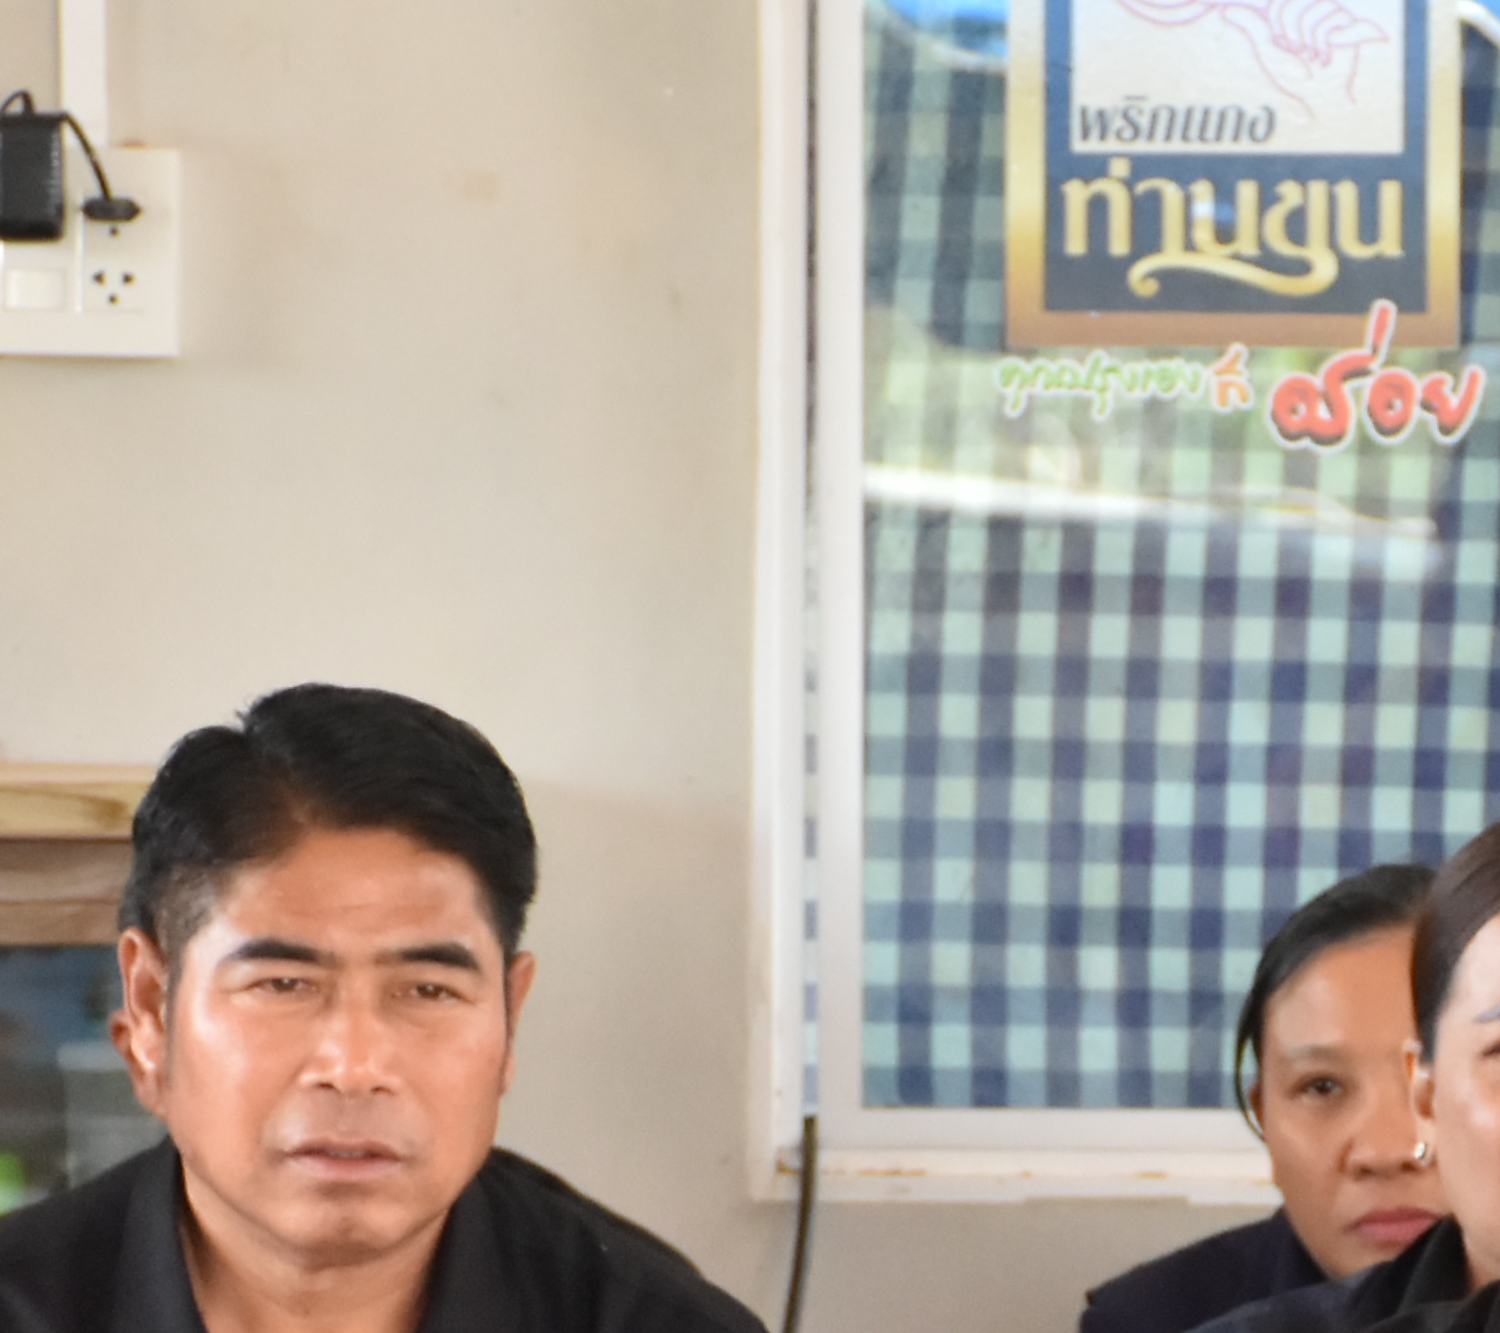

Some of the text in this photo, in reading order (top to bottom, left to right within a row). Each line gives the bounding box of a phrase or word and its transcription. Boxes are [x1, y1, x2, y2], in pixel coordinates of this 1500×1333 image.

[1078, 94, 1276, 145] พริกแกง
[1062, 156, 1403, 298] ท่านขุน
